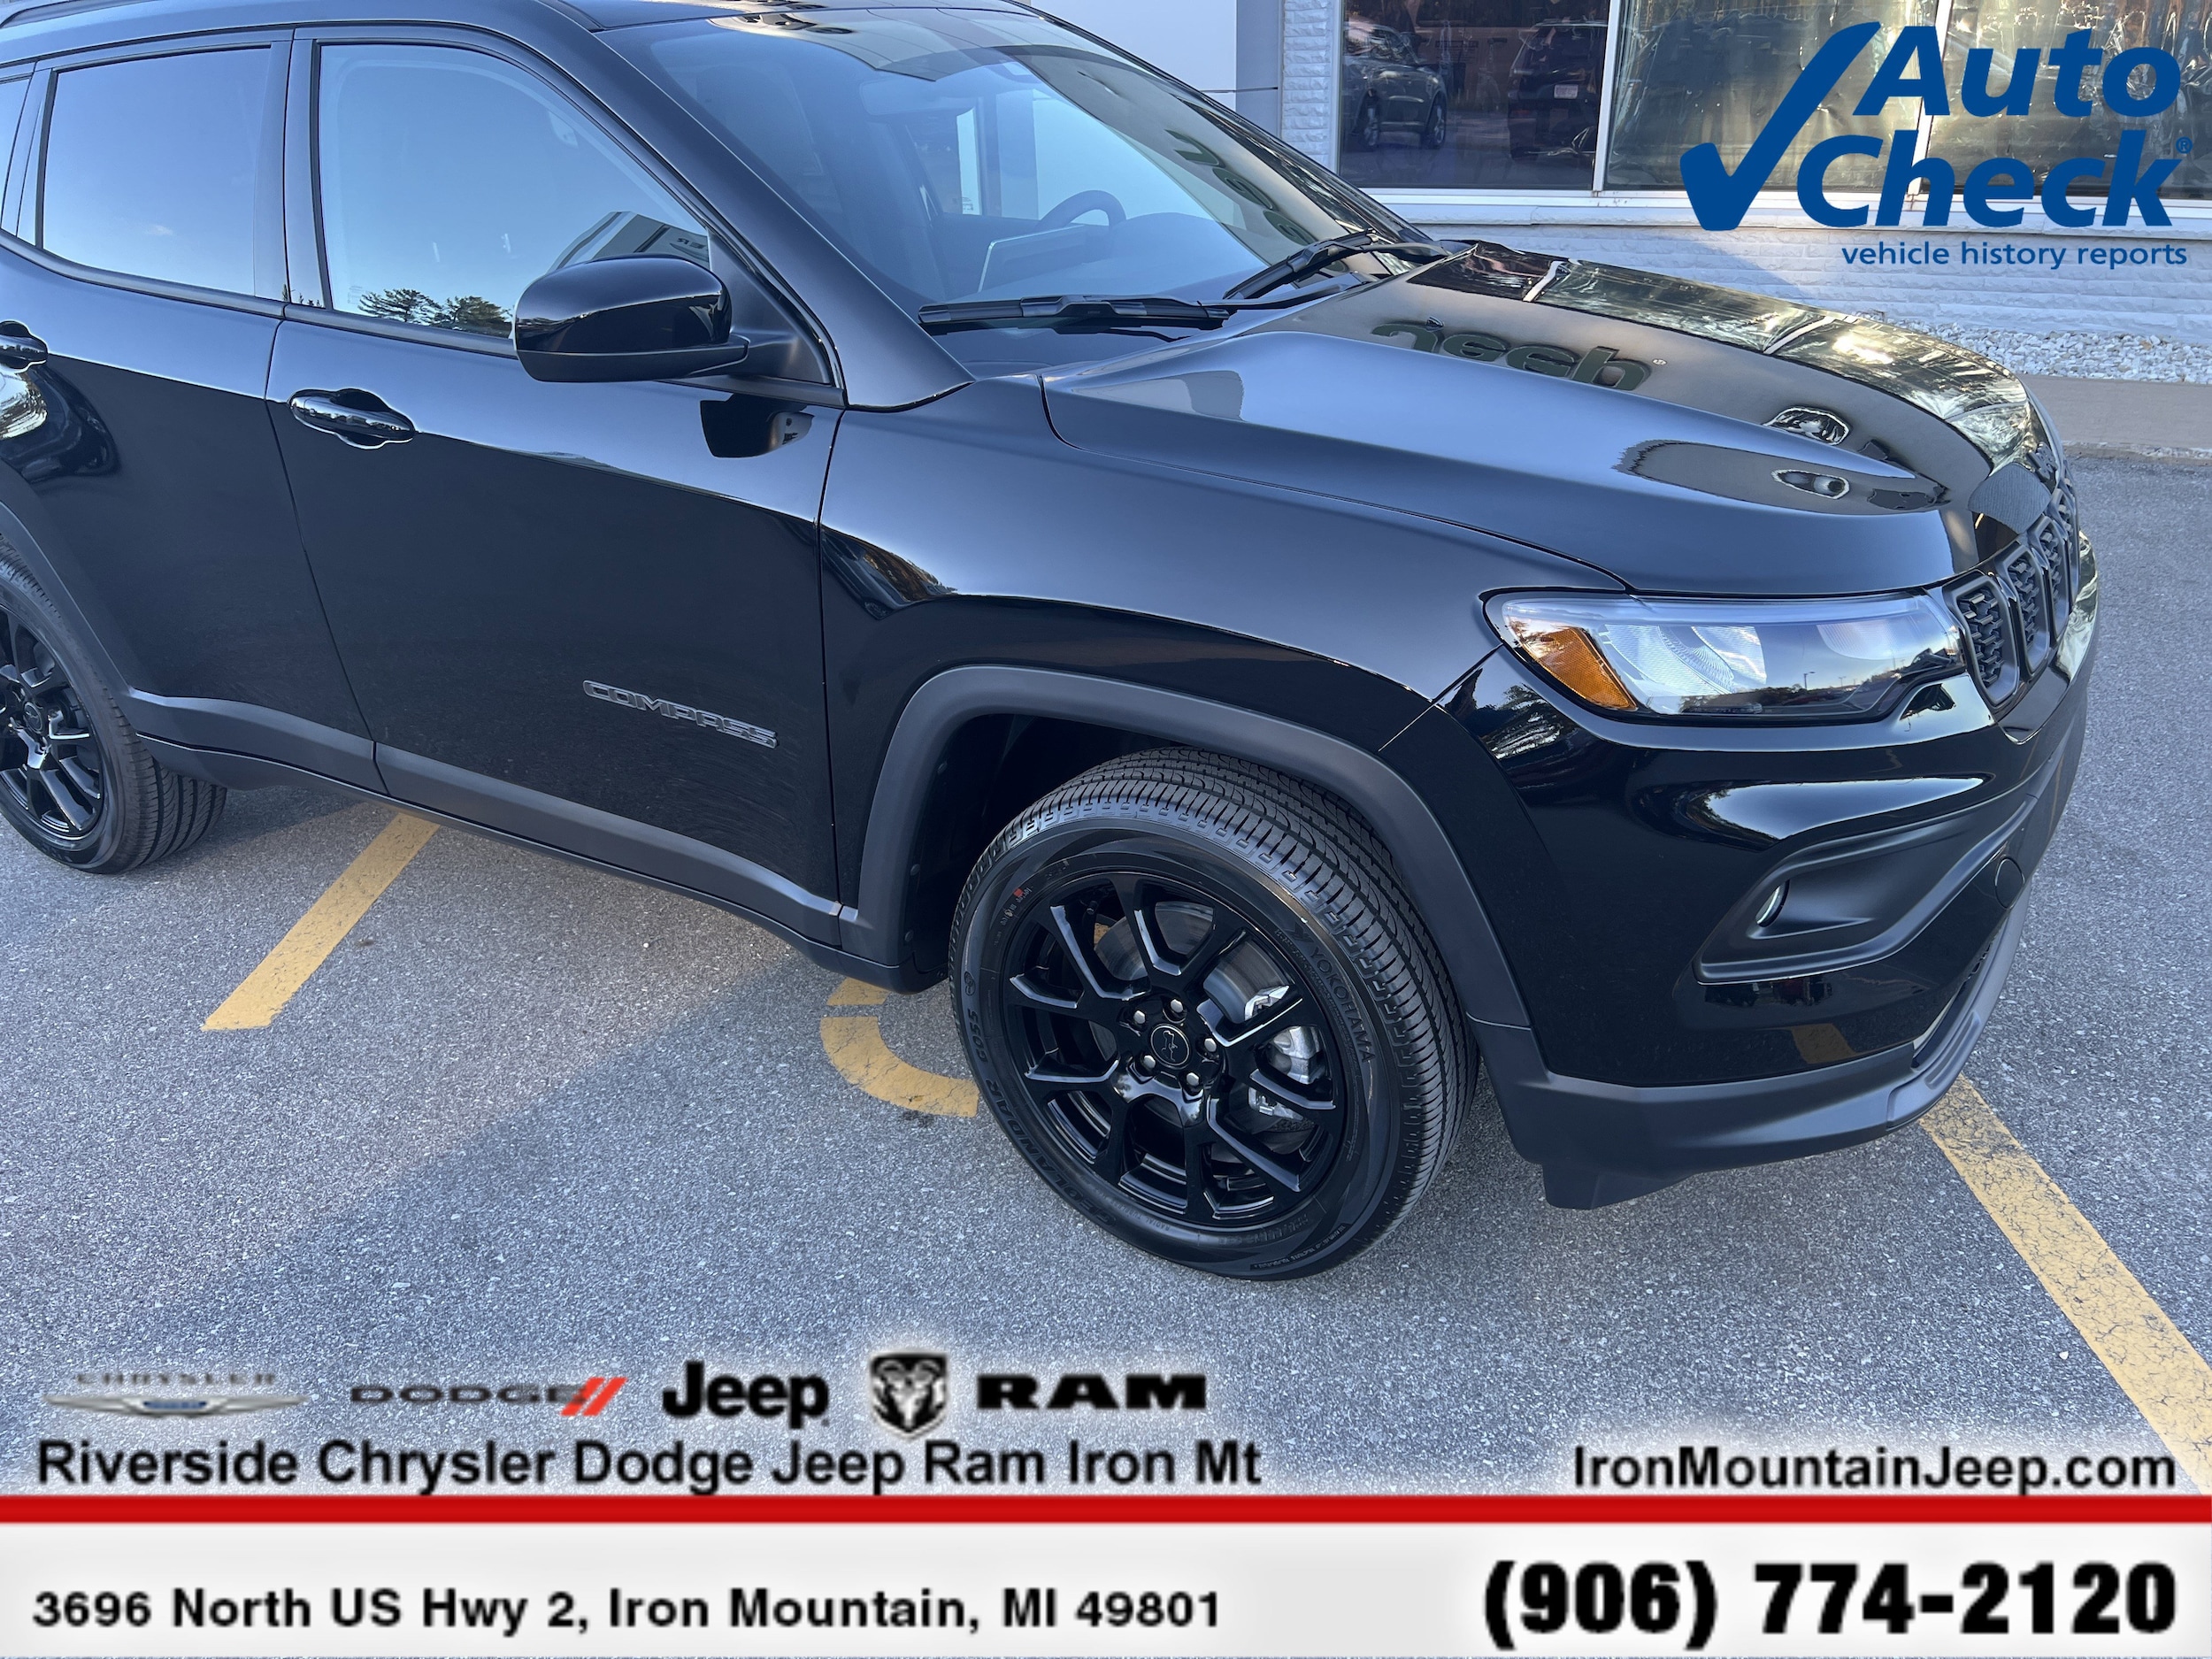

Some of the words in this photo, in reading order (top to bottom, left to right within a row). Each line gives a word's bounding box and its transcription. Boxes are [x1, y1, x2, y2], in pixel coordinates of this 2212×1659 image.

[583, 680, 778, 749] COMPASS
[1310, 945, 1377, 1063] YOKOHAMA
[985, 1079, 1117, 1227] GEOLANDAR
